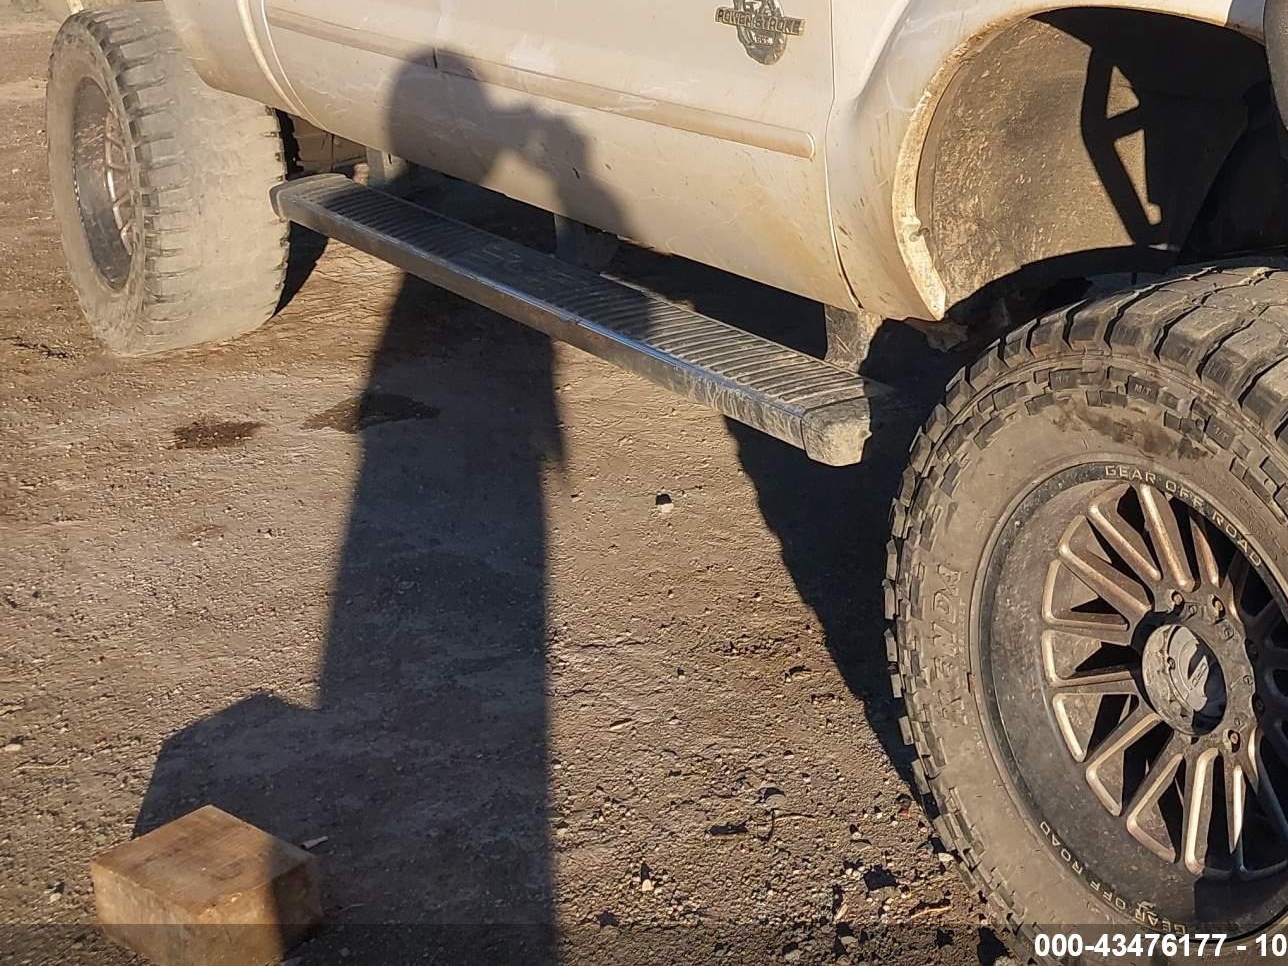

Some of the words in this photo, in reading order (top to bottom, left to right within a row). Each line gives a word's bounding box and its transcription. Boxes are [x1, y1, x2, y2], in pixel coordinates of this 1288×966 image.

[1104, 464, 1157, 484] GEAR
[1165, 479, 1206, 510] OFF
[1211, 513, 1263, 567] ROAD
[1039, 820, 1084, 876] ROAD
[1089, 879, 1128, 911] OFF
